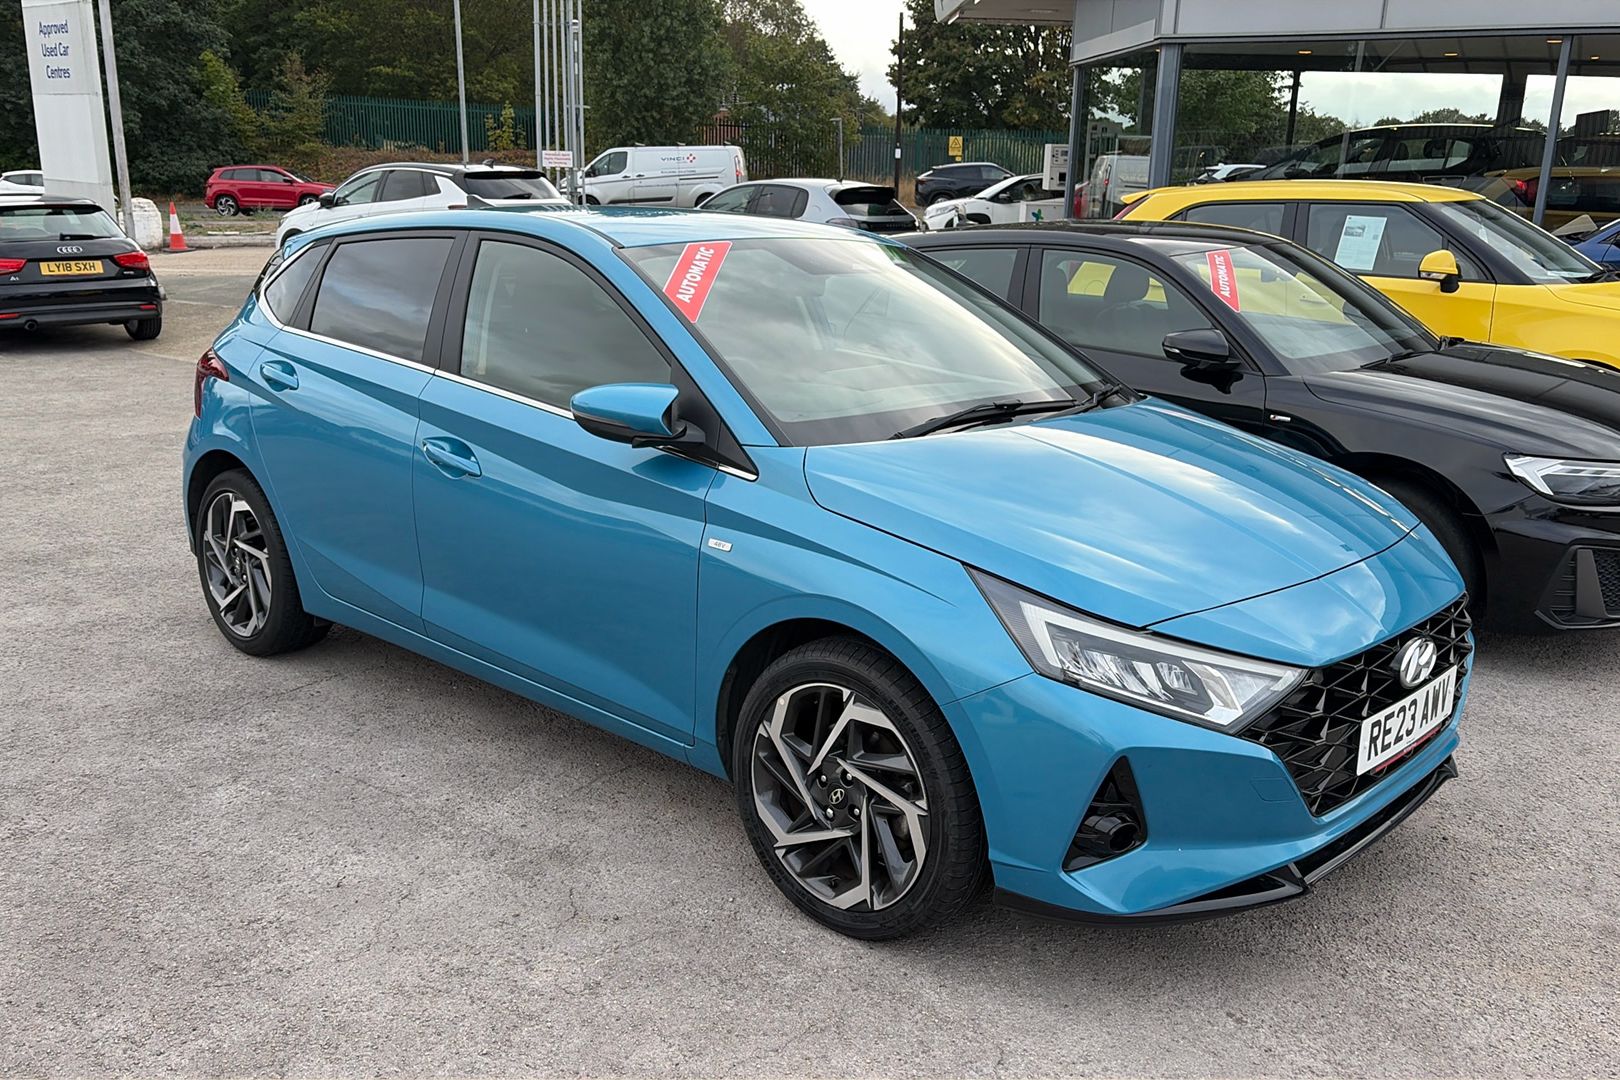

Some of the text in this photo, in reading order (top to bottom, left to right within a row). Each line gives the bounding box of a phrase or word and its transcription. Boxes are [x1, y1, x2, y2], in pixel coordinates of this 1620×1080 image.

[39, 19, 69, 38] Approved
[41, 42, 69, 57] Used Car
[46, 65, 71, 79] Centres
[47, 262, 96, 273] LY18 SXH
[676, 246, 715, 304] AUTOMATIC
[1214, 254, 1231, 298] AUTOMATIC
[1367, 674, 1450, 762] RE23 AWV
